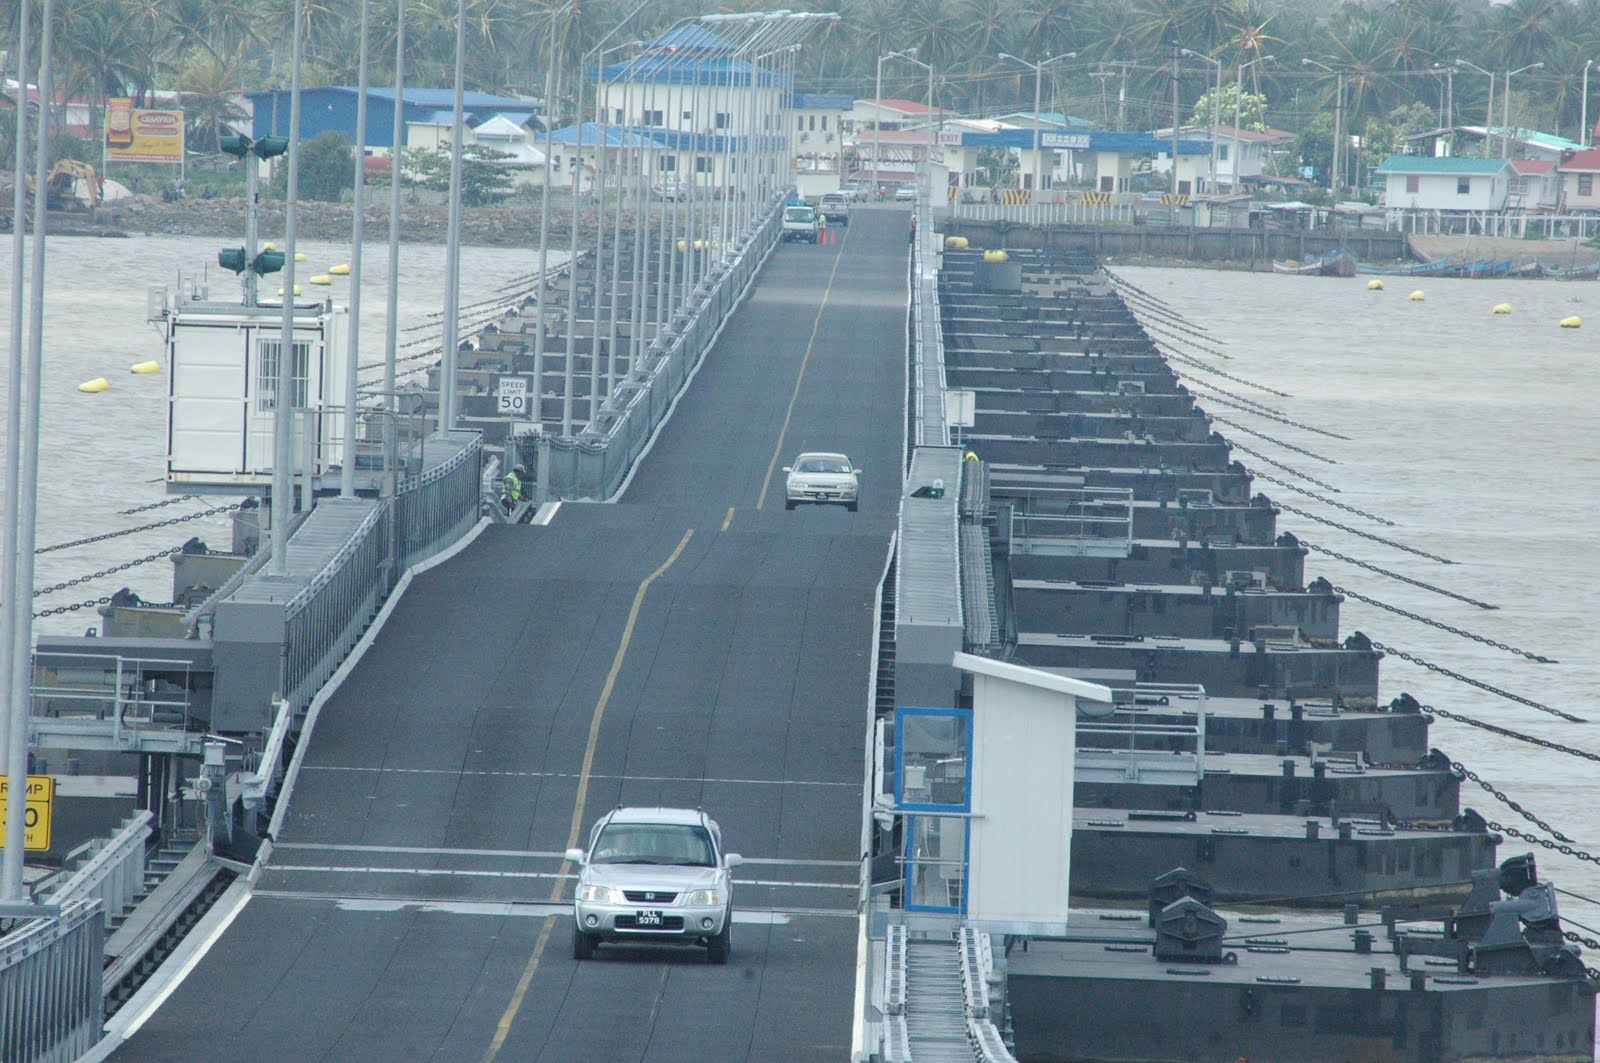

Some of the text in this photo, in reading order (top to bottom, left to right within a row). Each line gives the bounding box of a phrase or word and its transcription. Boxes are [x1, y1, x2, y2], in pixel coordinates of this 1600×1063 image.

[940, 134, 959, 143] EXIT
[501, 381, 525, 389] SPEED
[501, 396, 523, 409] 50
[0, 782, 43, 795] RMP
